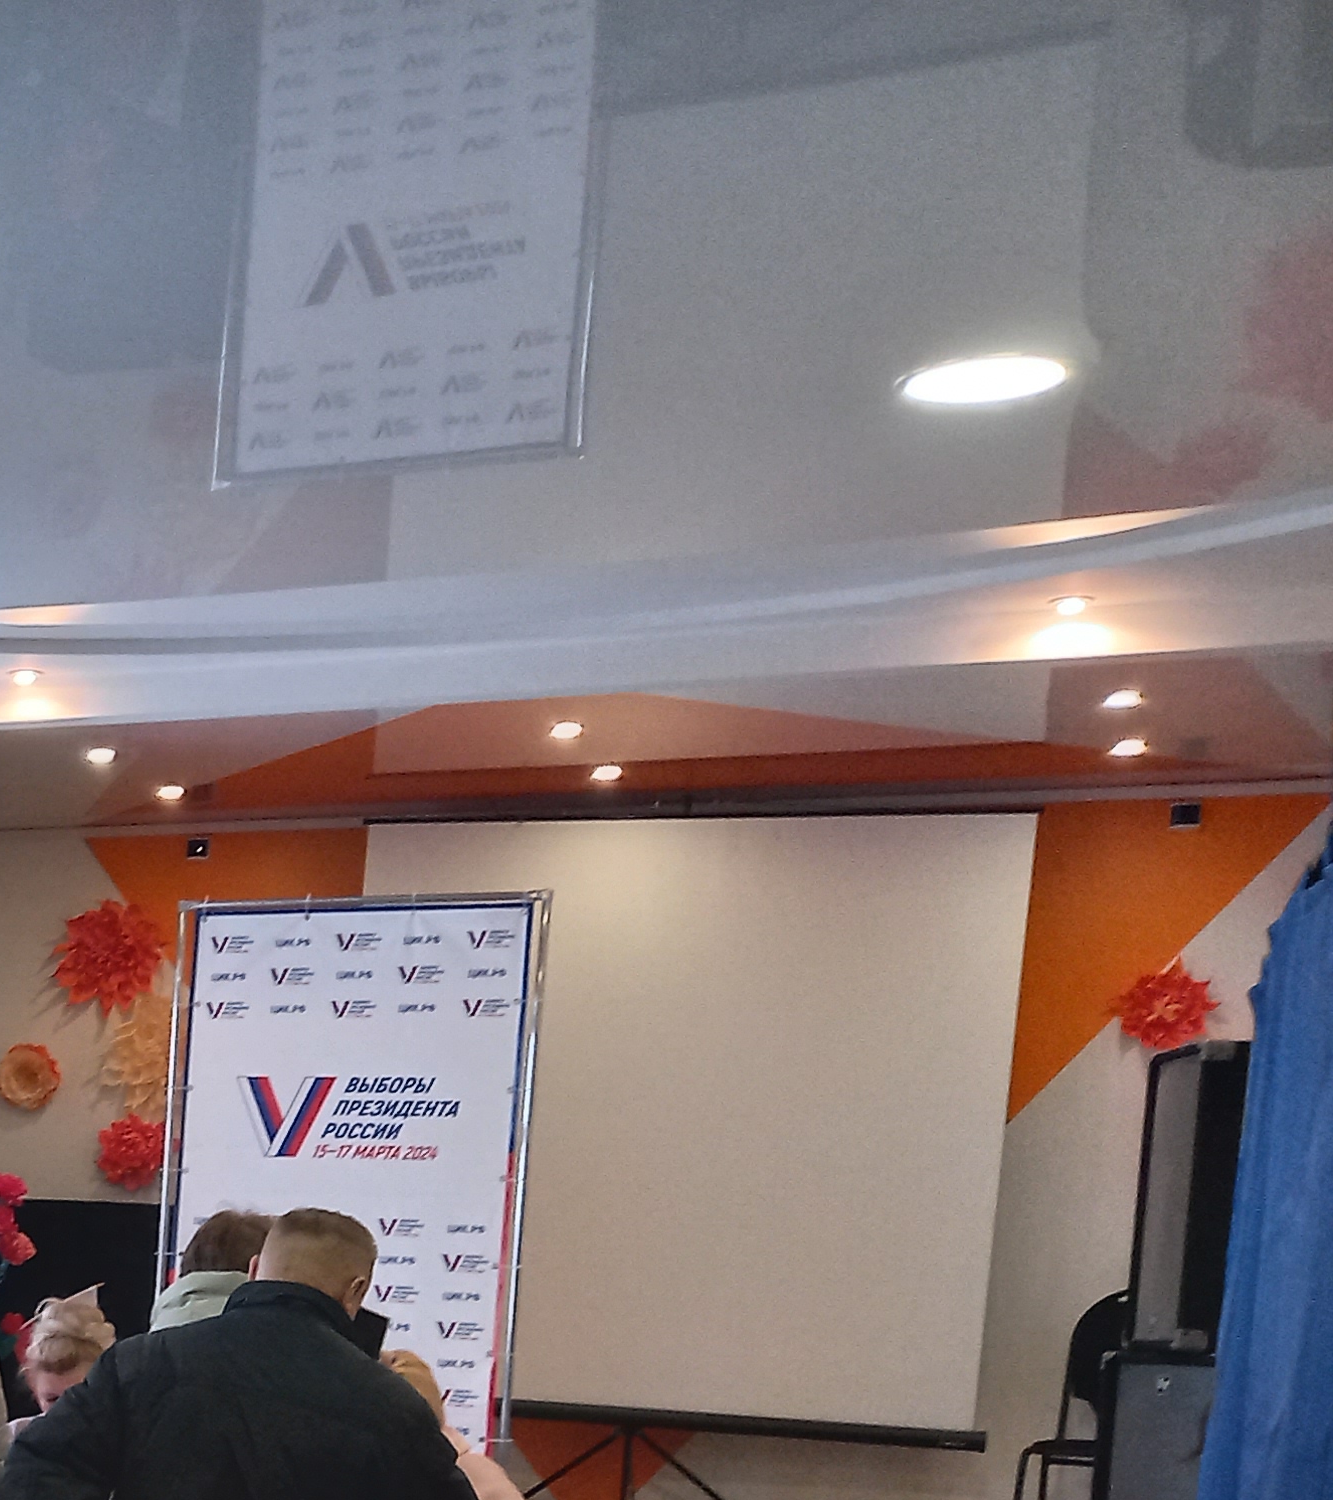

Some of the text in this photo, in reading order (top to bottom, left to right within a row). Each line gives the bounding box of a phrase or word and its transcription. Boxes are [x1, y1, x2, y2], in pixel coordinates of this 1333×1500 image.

[344, 1076, 436, 1094] ВЫБОРЫ
[332, 1099, 461, 1119] ПРЕЗИДЕНТА
[320, 1121, 404, 1140] РОССИИ
[351, 1144, 401, 1160] МАРТА
[402, 1145, 439, 1161] 2024
